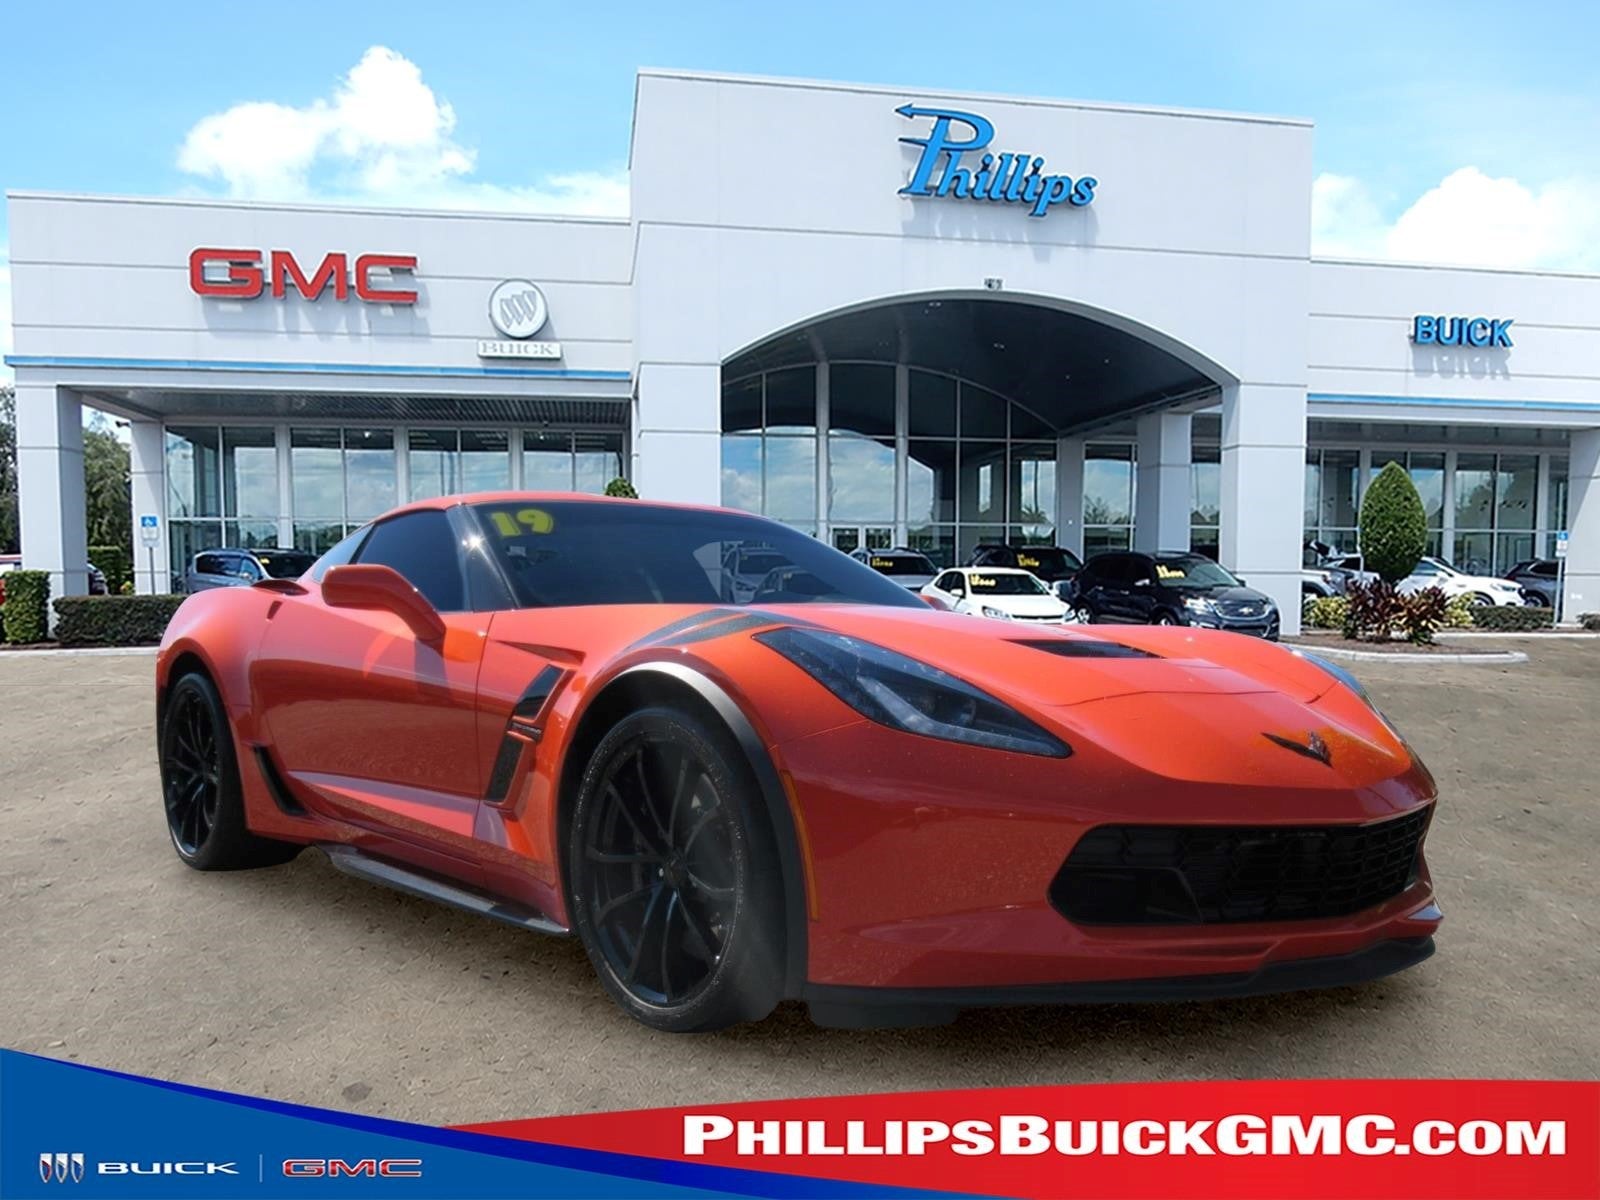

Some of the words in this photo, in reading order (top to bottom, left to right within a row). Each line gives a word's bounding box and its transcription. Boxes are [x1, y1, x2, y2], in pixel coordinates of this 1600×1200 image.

[894, 103, 1098, 217] Phillips
[189, 247, 418, 304] GMC
[1413, 314, 1514, 347] BUICK
[481, 342, 554, 355] BUICK
[490, 509, 553, 537] 19
